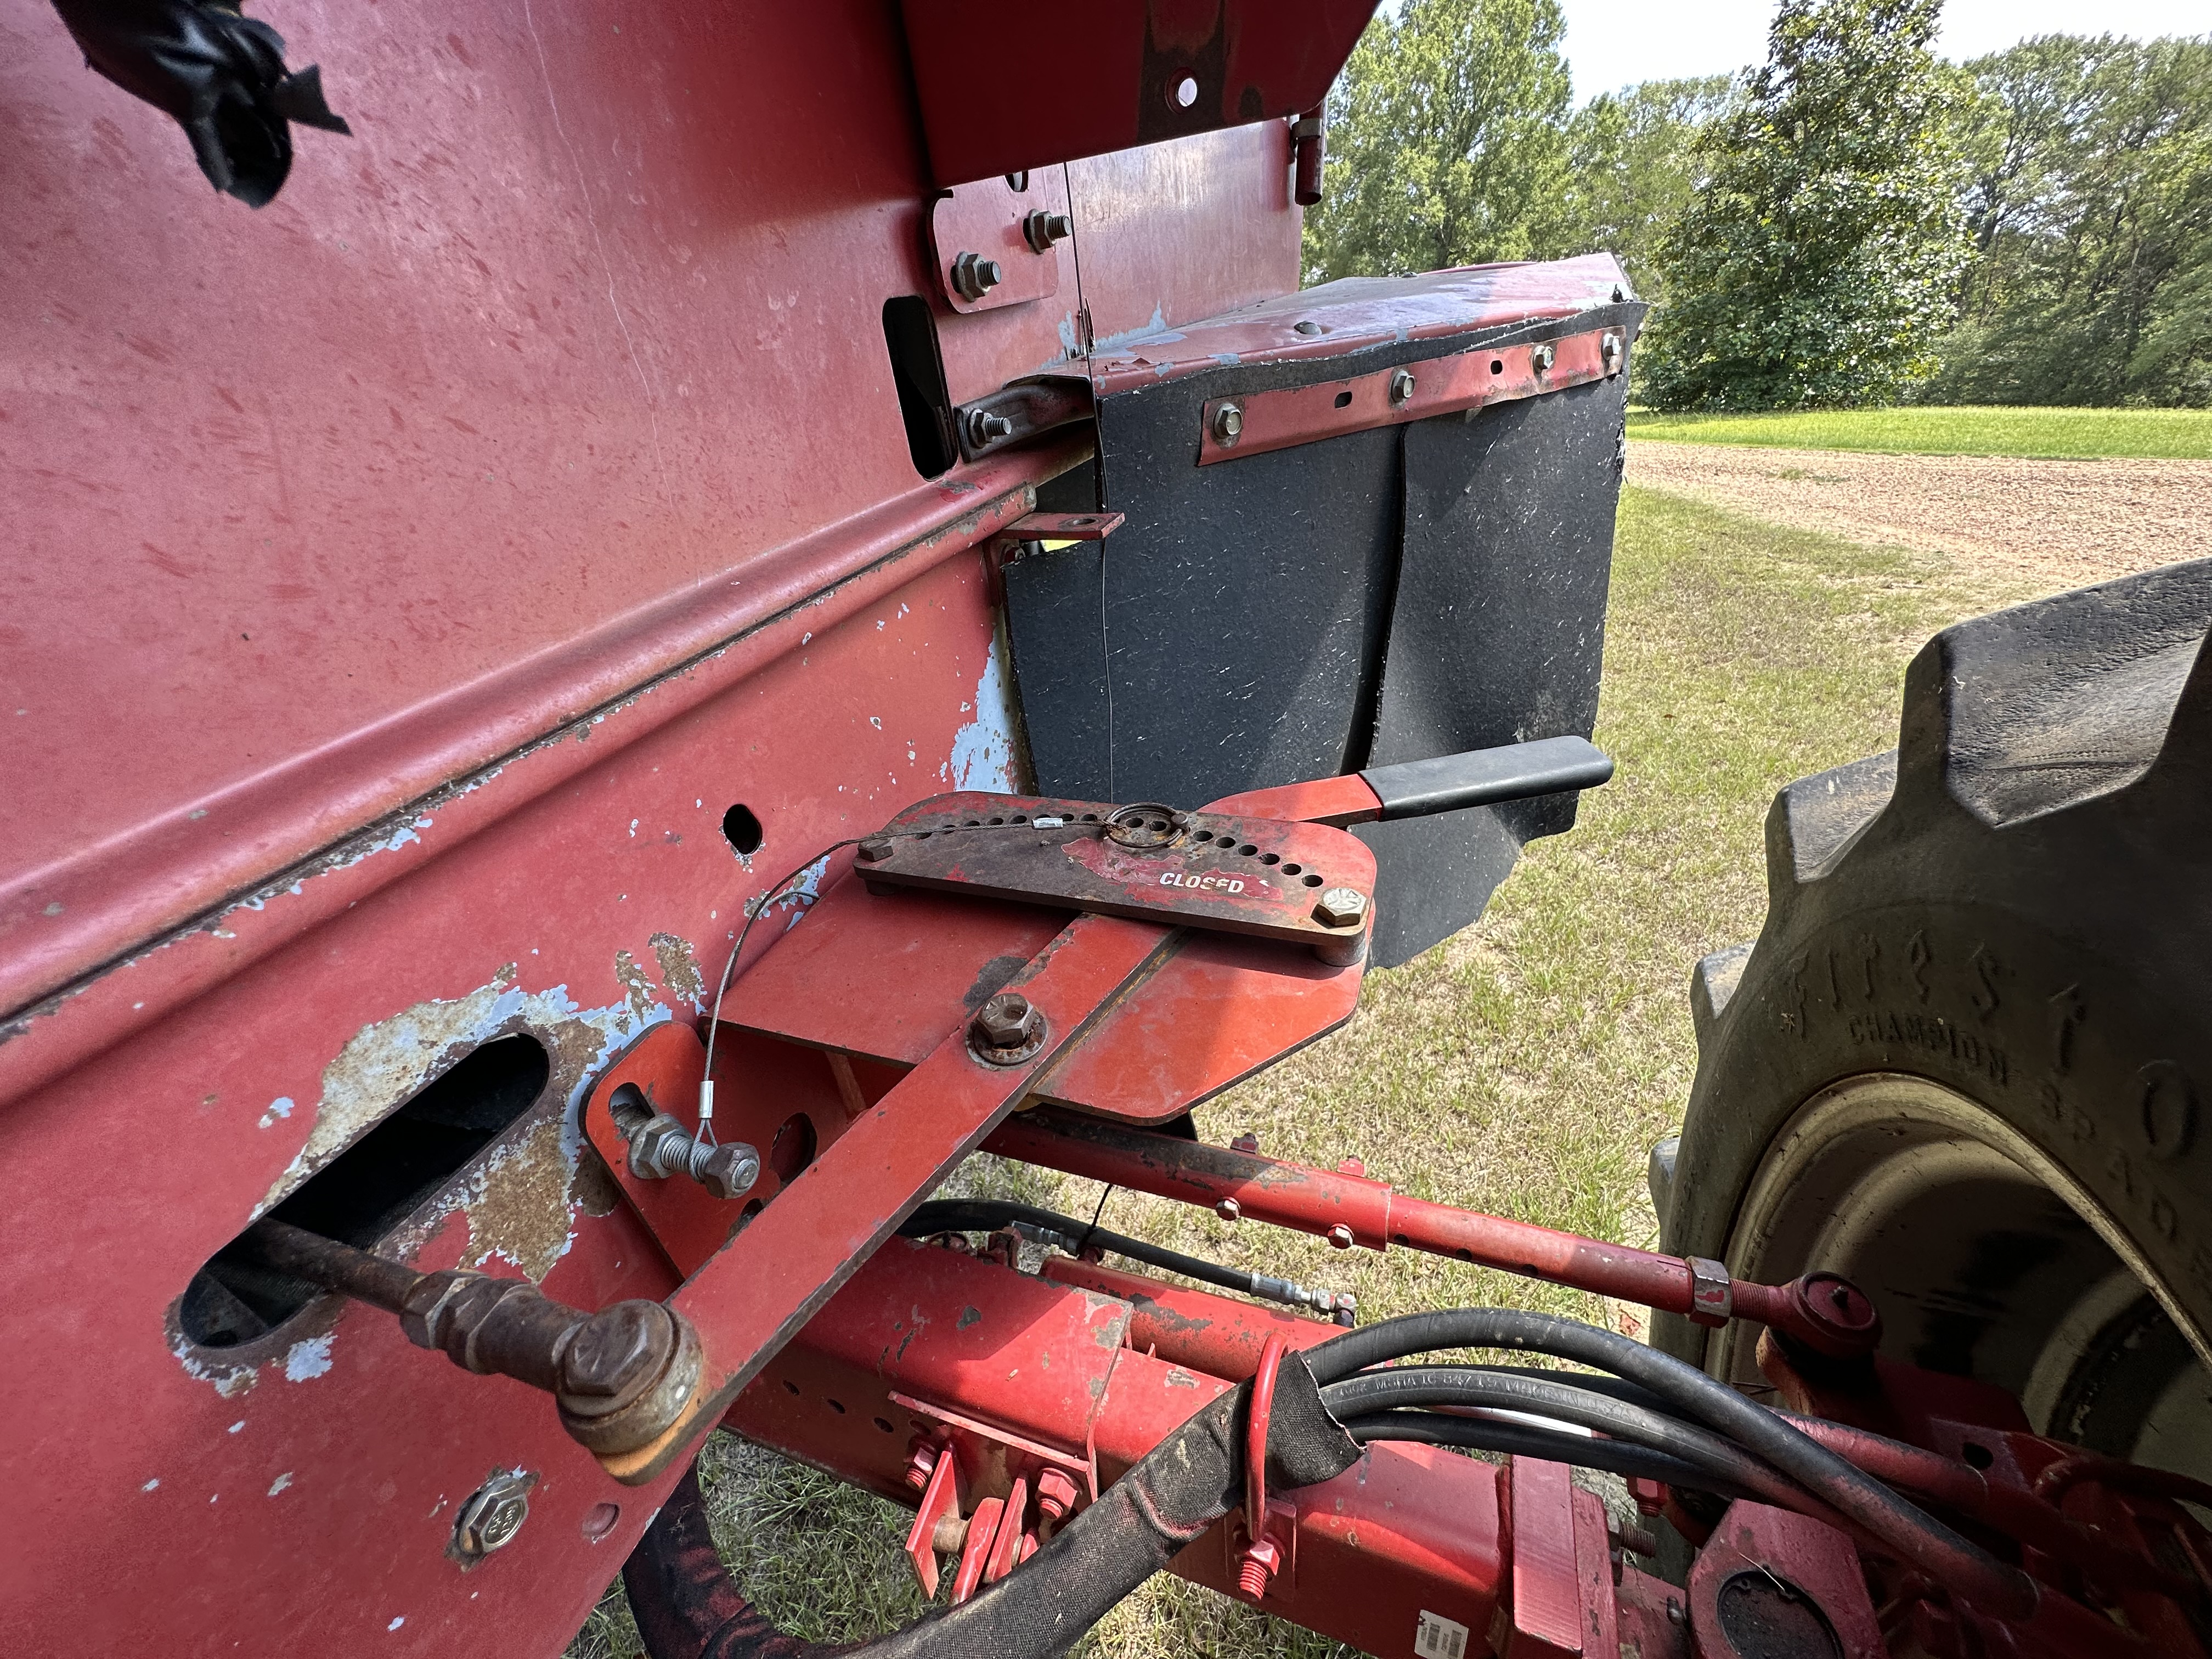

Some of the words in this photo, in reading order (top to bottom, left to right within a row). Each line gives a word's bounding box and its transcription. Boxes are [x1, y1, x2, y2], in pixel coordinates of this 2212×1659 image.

[1159, 872, 1245, 893] CLOSED
[1848, 1009, 2010, 1087] CHAMPION
[1505, 1379, 1555, 1400] MADE
[1562, 1390, 1580, 1406] IN
